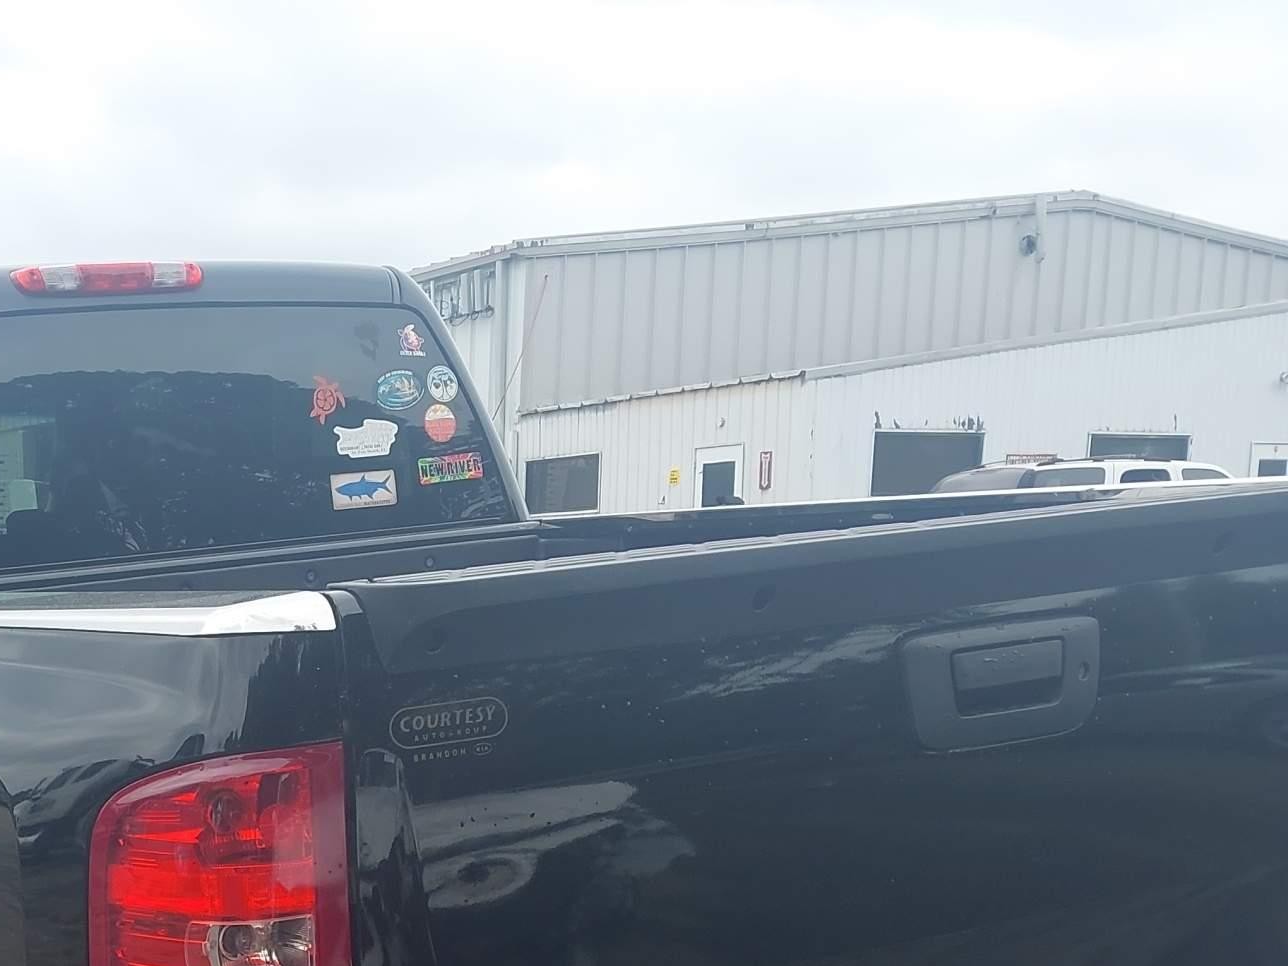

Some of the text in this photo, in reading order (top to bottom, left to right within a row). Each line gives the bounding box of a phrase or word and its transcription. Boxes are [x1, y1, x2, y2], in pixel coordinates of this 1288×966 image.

[446, 458, 481, 476] RIVER
[399, 704, 496, 733] COURTESY
[448, 724, 488, 738] ROUP
[413, 747, 467, 763] BRANDON
